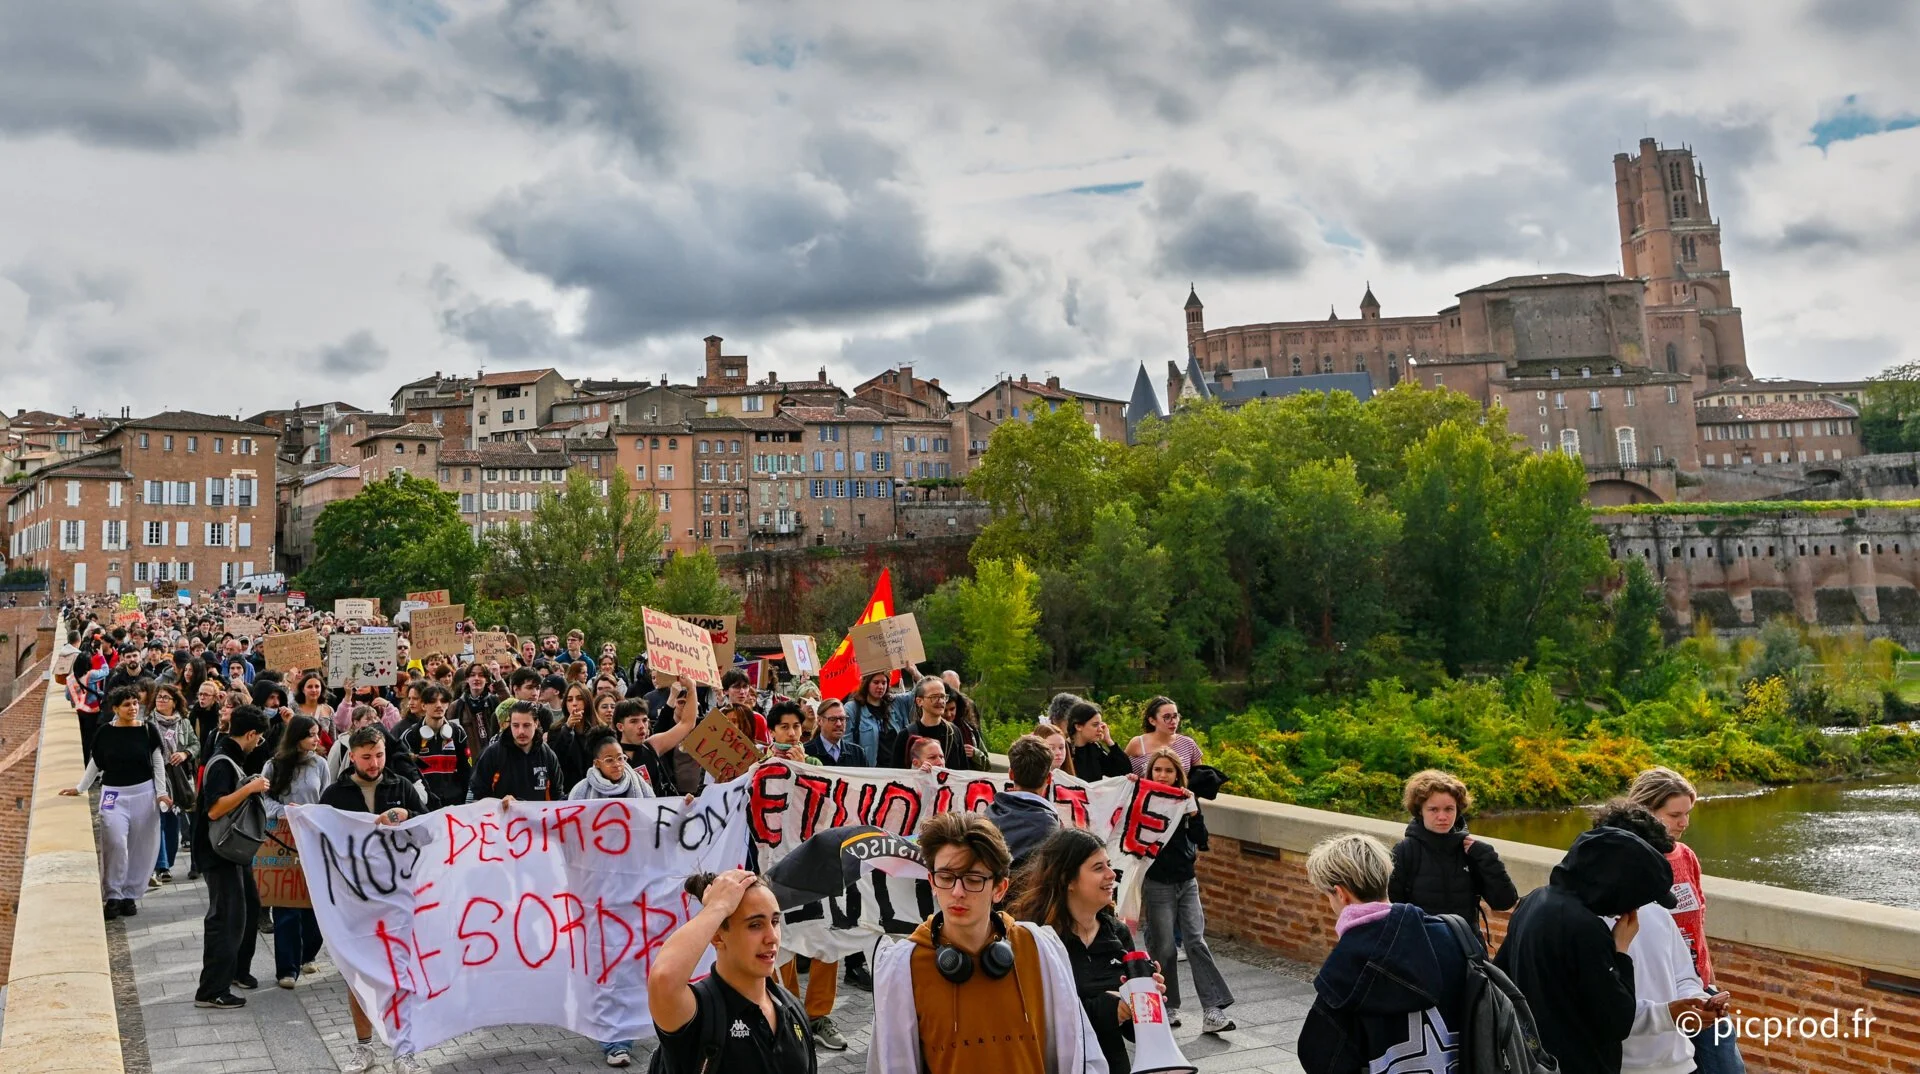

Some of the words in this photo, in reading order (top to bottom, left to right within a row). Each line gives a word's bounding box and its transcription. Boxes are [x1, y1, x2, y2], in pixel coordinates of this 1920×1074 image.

[677, 620, 699, 641] 404
[320, 828, 421, 906] NOS
[376, 882, 711, 1030] DÉSORDR
